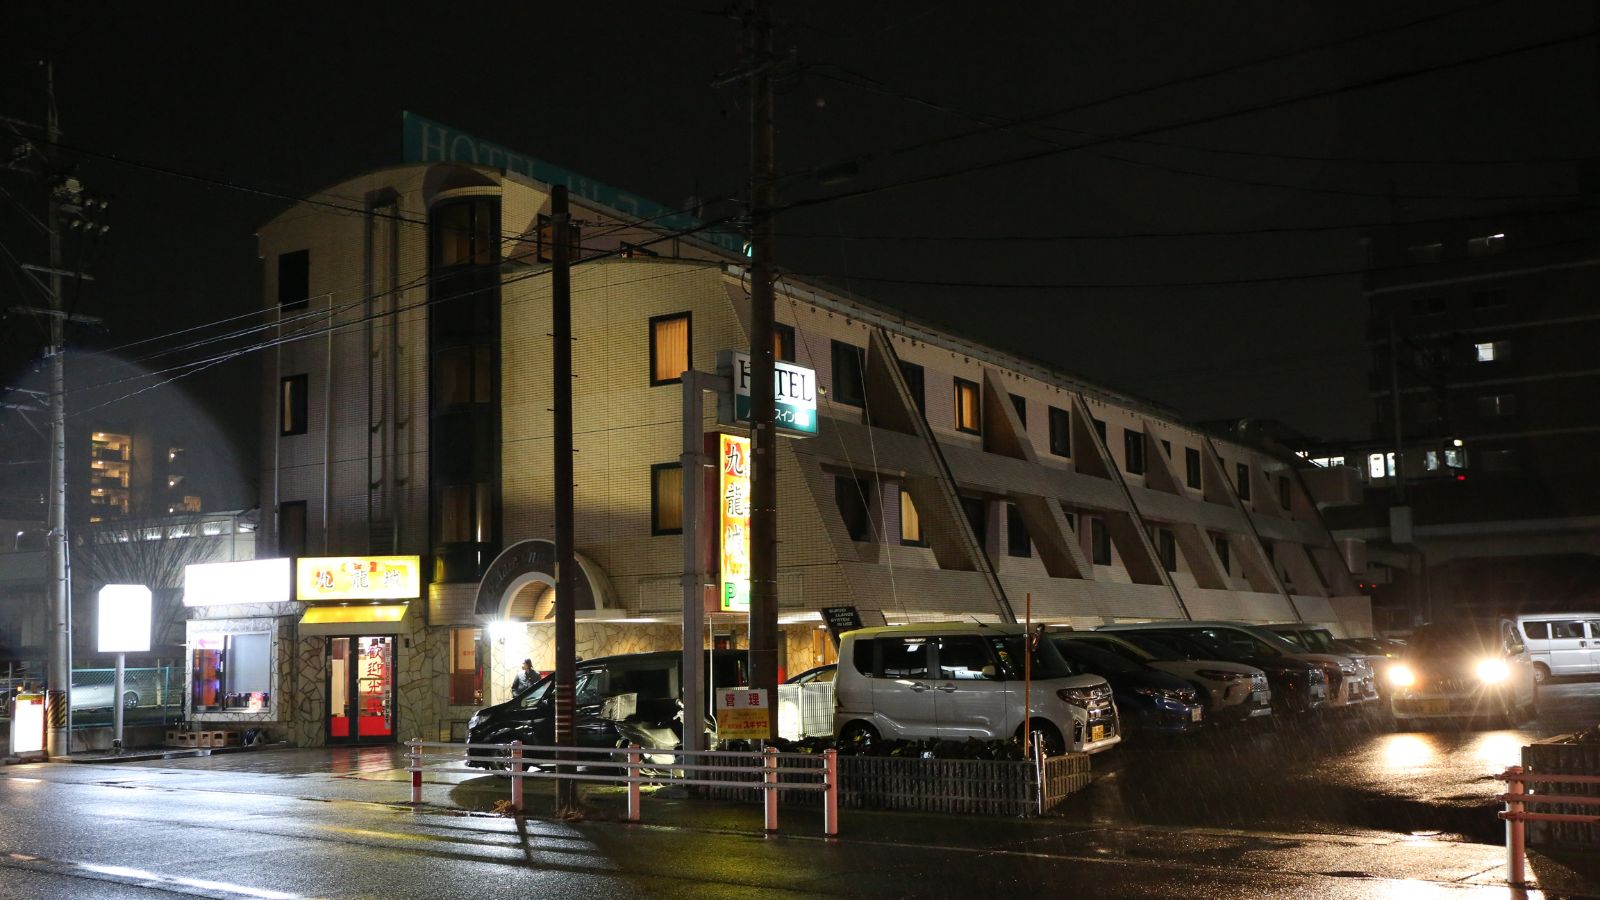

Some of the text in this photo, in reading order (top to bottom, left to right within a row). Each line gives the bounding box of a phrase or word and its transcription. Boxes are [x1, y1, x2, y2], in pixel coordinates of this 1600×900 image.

[420, 122, 537, 179] HOTEL
[738, 360, 812, 401] HTEL
[724, 581, 737, 607] P
[725, 693, 760, 707] 管理
